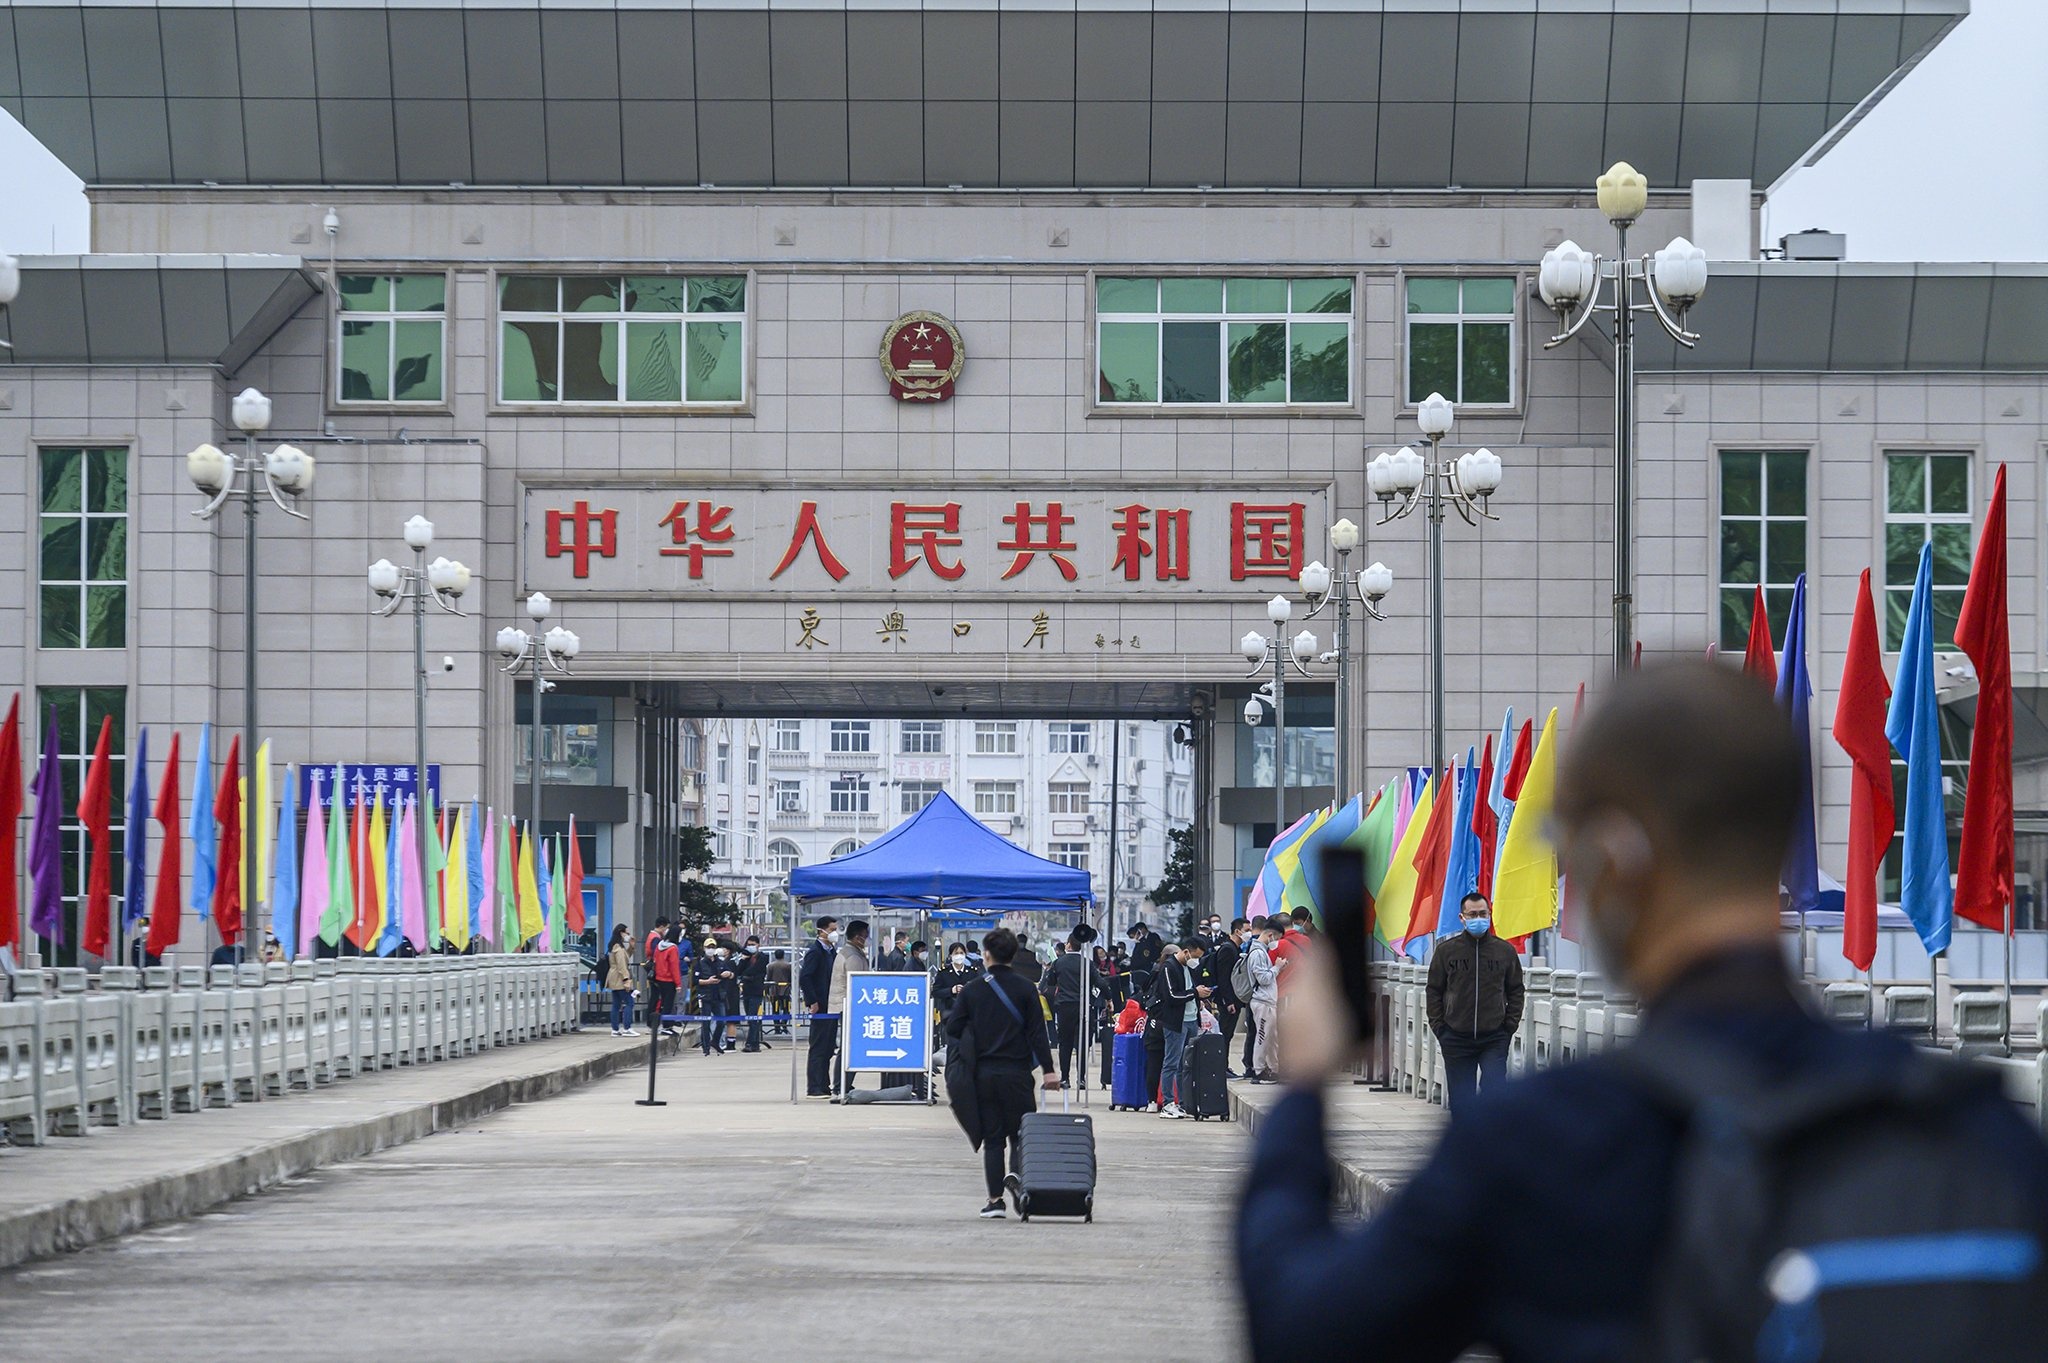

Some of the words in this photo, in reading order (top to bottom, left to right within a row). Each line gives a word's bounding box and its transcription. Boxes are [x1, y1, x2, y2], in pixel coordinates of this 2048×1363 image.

[545, 500, 1306, 582] 中华人民共和国
[894, 759, 951, 777] 江西饭店
[857, 988, 920, 1005] 入境人员
[862, 1015, 913, 1040] 通道
